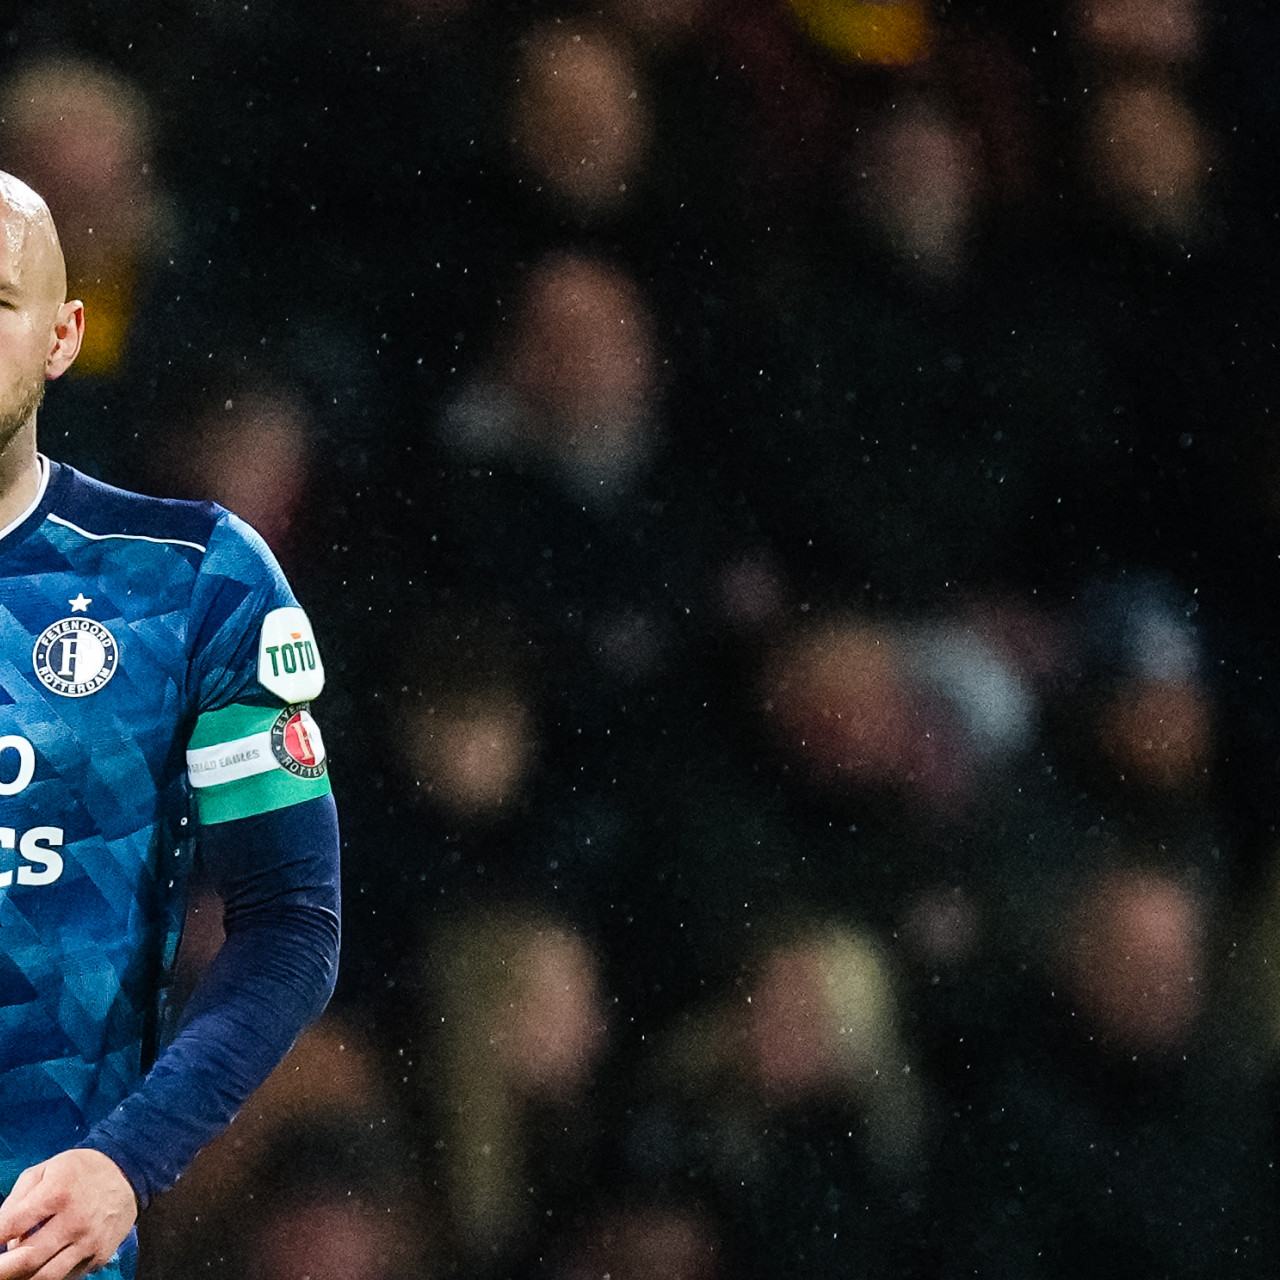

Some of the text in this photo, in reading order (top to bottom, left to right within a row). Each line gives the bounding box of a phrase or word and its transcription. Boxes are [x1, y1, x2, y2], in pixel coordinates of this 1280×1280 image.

[41, 620, 112, 648] FEYENOORD
[265, 640, 316, 677] TOTO
[38, 666, 110, 694] ROTTERDAM
